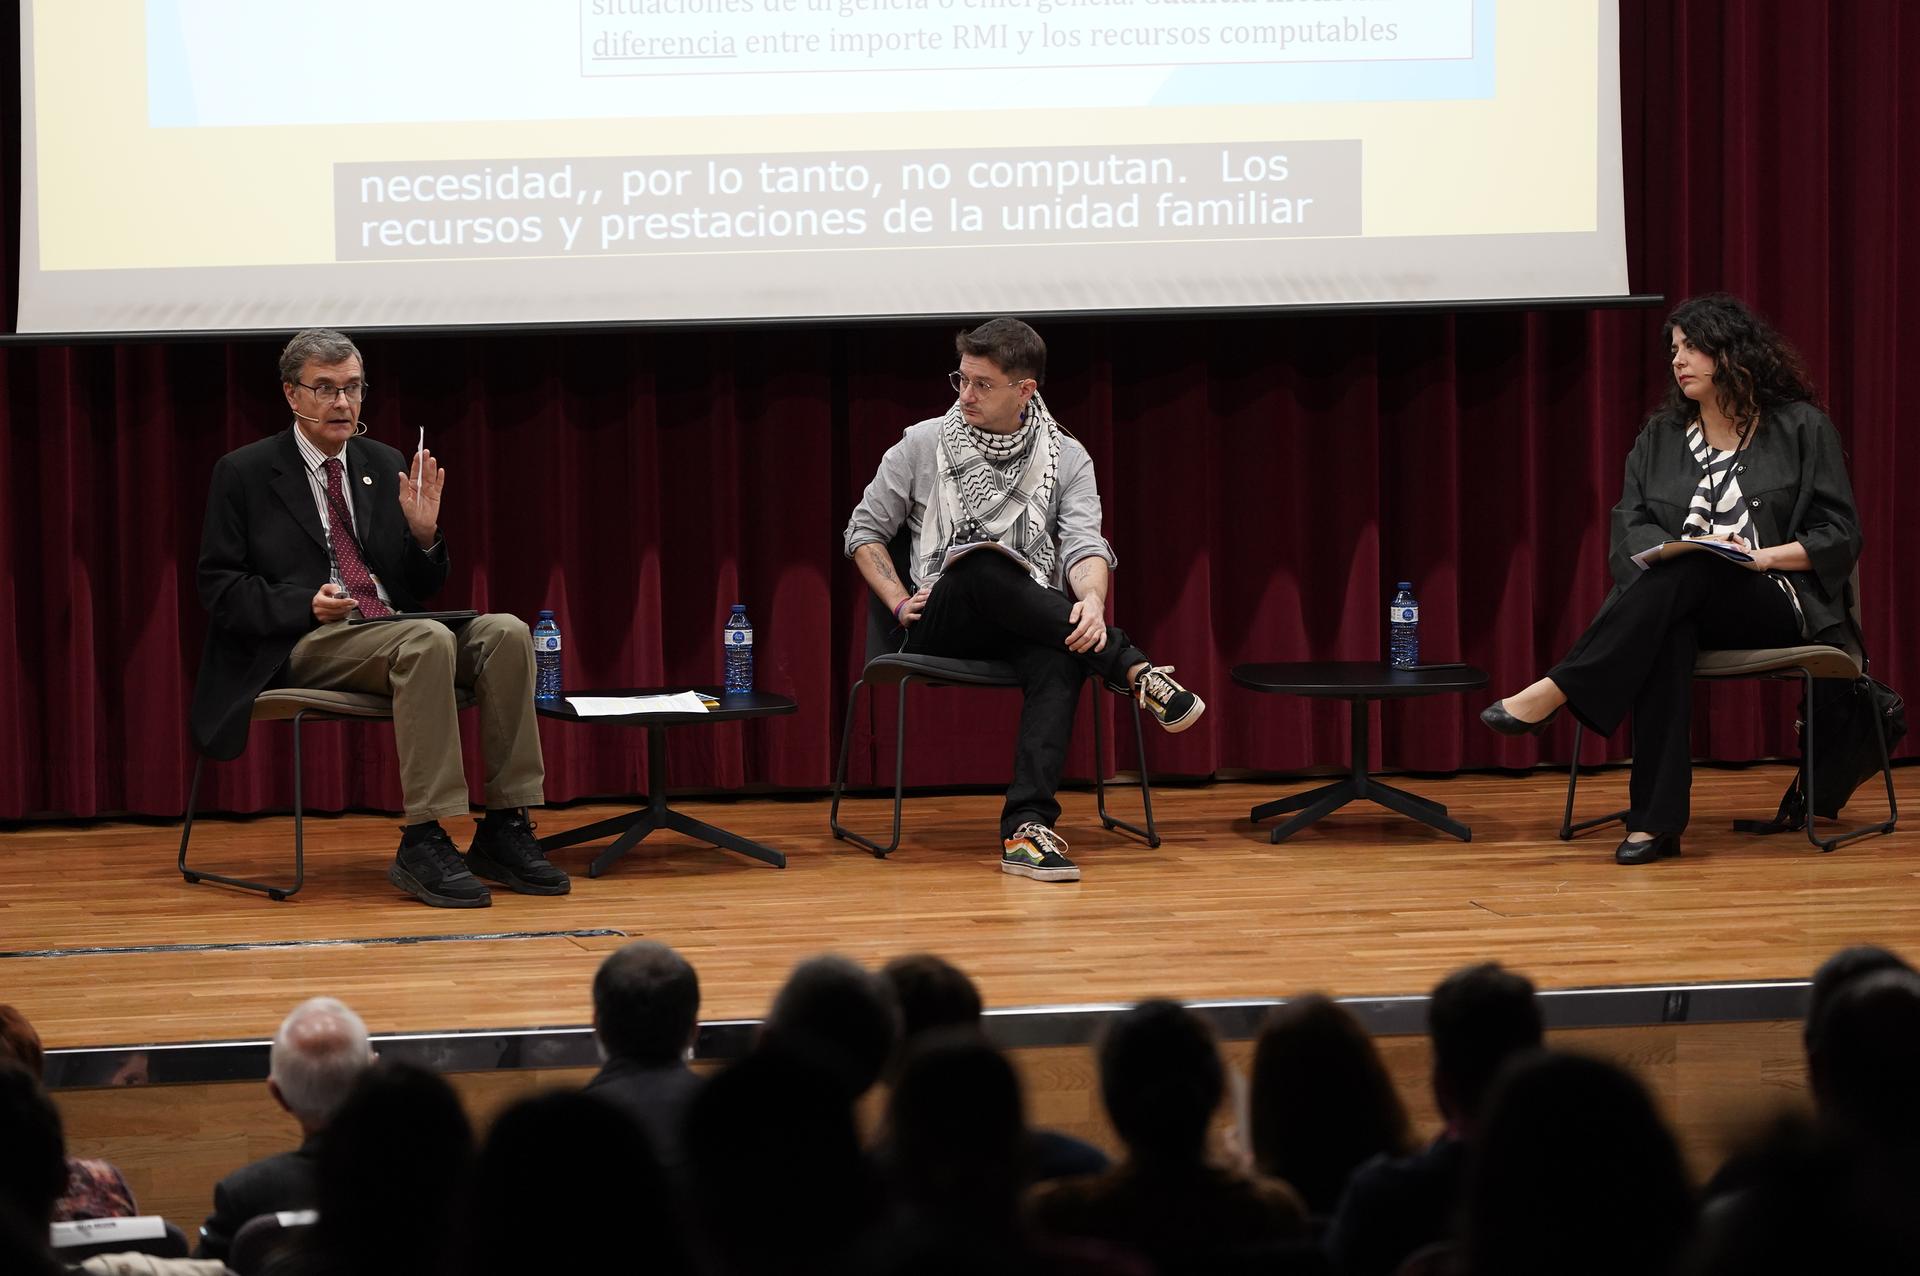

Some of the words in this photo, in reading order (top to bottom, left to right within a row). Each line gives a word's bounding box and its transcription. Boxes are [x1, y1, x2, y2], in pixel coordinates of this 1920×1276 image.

[592, 0, 754, 15] situaciones
[592, 30, 738, 57] diferencia
[745, 32, 821, 54] entre
[829, 27, 943, 59] importe
[953, 24, 1008, 50] RMI
[1016, 30, 1035, 56] y
[1042, 22, 1081, 48] los
[1090, 26, 1211, 47] recursos
[1219, 16, 1399, 51] computables
[360, 165, 603, 205] necesidad,,
[623, 168, 692, 205] por
[708, 161, 743, 195] lo
[758, 161, 882, 199] tanto,
[901, 162, 952, 191] no
[967, 154, 1187, 195] computan.
[1222, 150, 1289, 183] Los
[361, 215, 544, 247] recursos
[558, 216, 584, 250] y
[600, 205, 867, 249] prestaciones
[883, 198, 933, 234] de
[951, 197, 984, 232] la
[1002, 192, 1139, 230] unidad
[1156, 190, 1313, 227] familiar
